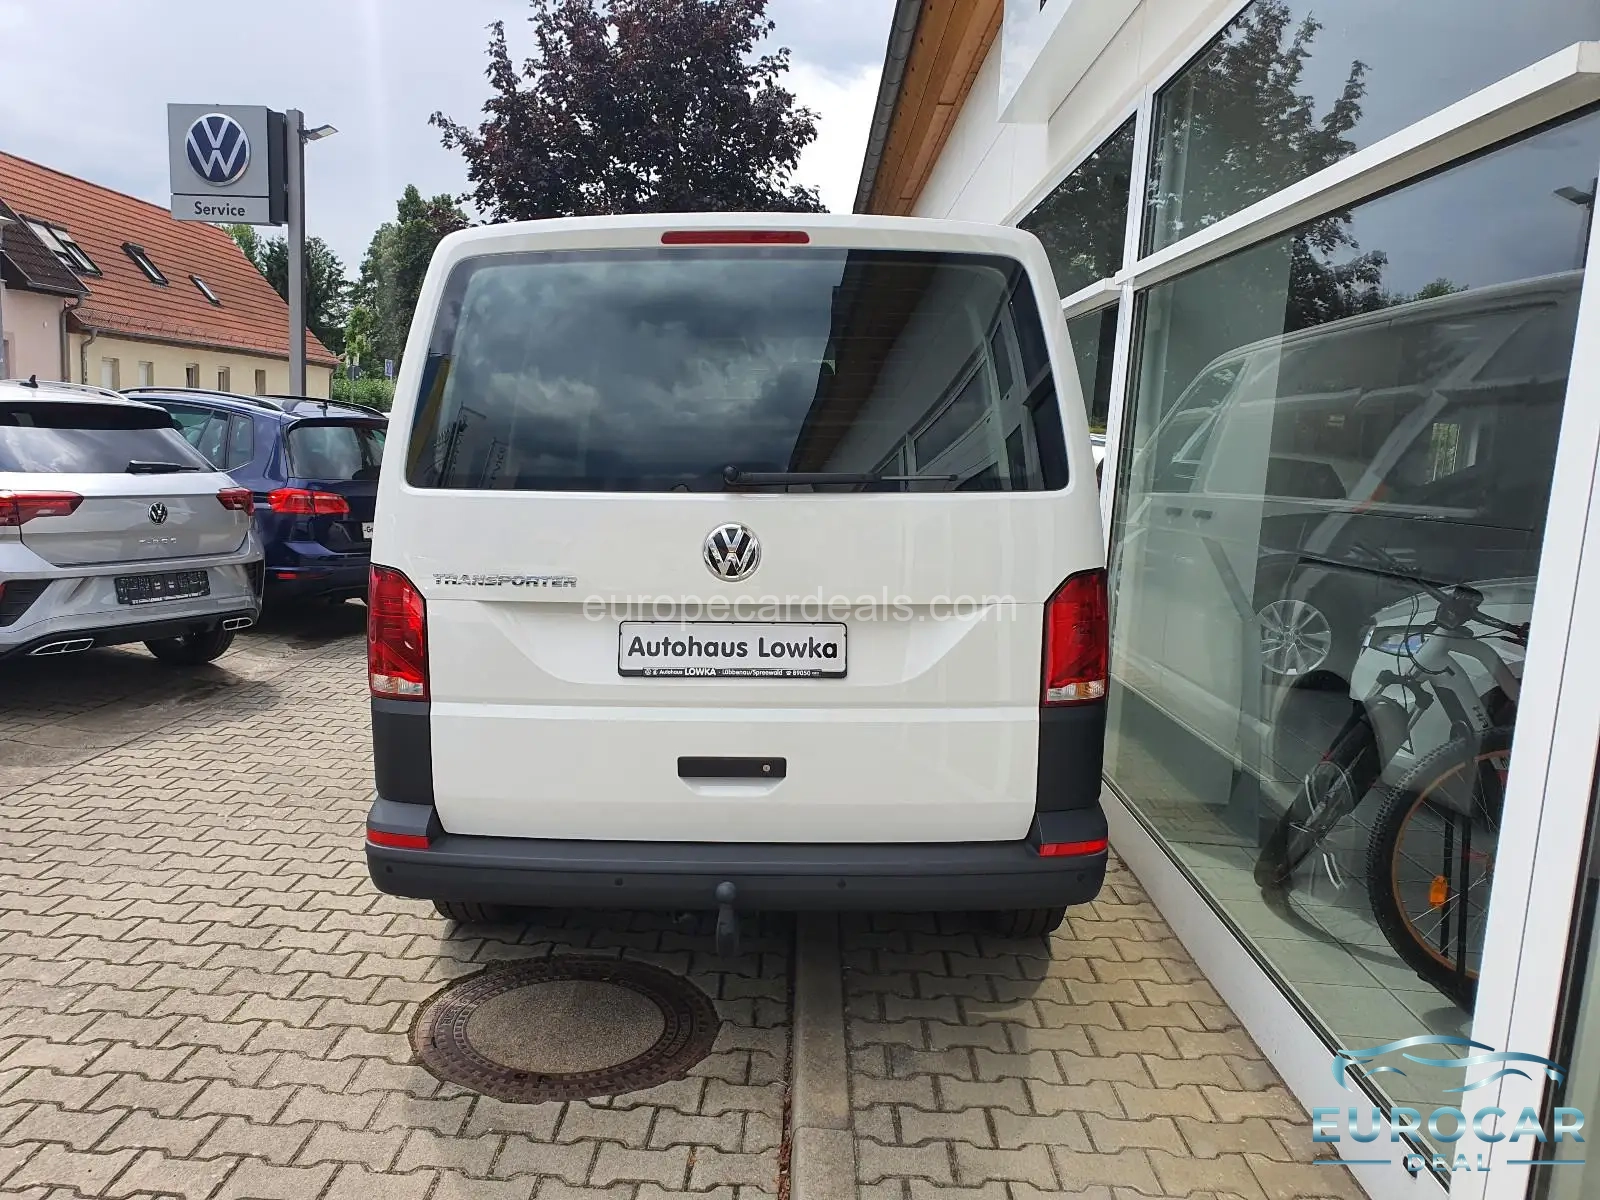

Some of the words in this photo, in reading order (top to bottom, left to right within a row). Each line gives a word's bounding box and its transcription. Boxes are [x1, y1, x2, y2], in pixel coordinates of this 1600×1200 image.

[186, 114, 250, 185] VW
[194, 200, 246, 217] Service
[703, 523, 761, 581] VW
[432, 573, 577, 588] TRANSPORTER
[627, 636, 749, 658] Autohaus
[758, 636, 838, 659] Lowka
[684, 667, 717, 676] LOWKA
